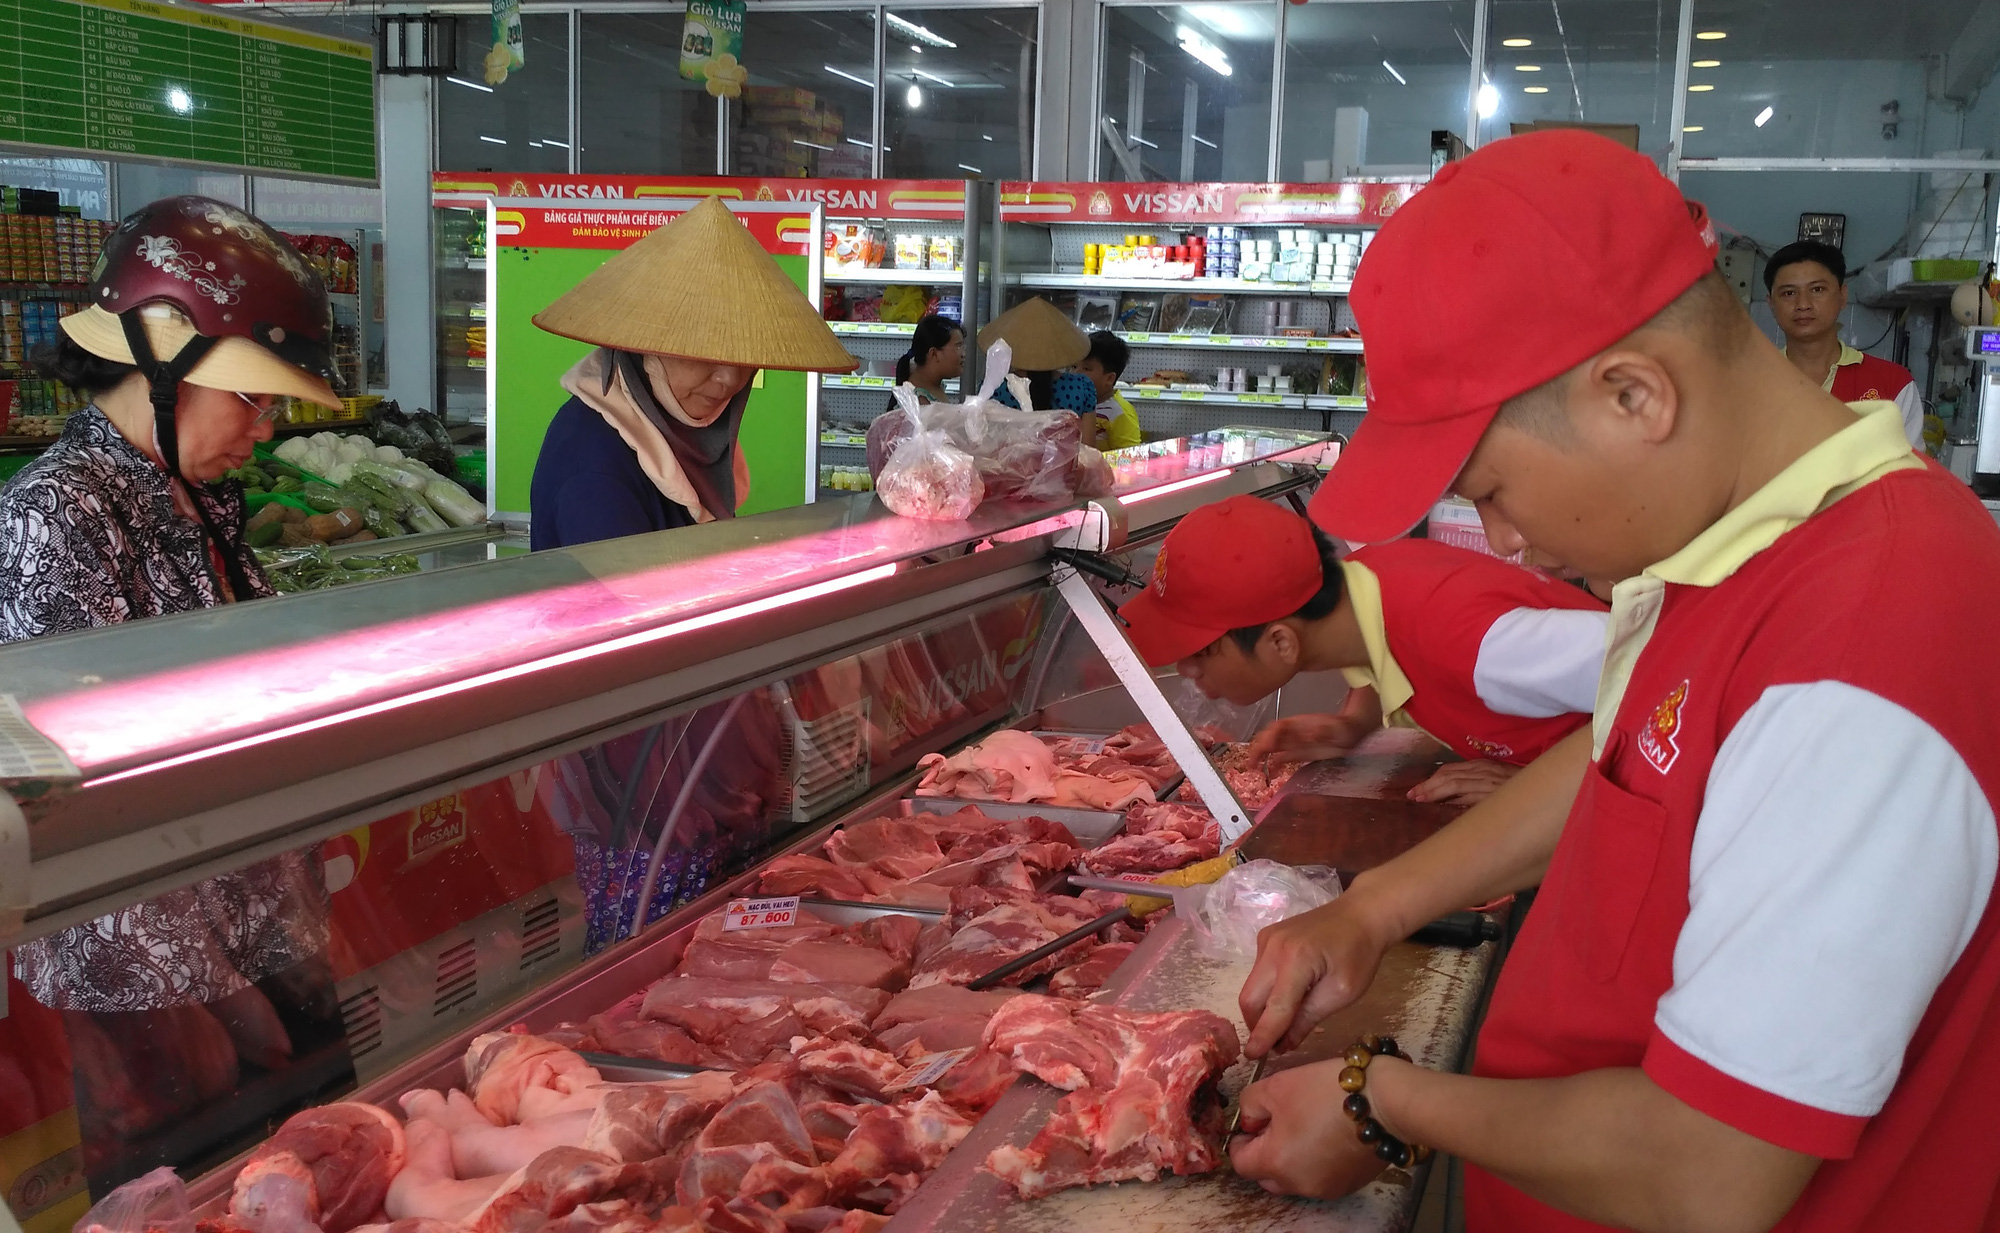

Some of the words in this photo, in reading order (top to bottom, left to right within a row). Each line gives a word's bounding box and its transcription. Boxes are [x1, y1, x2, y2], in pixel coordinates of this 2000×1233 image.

[690, 2, 714, 16] Giò
[786, 189, 877, 210] VISSAN
[1123, 193, 1224, 213] VISSAN
[544, 209, 568, 224] BẢNG
[568, 210, 582, 224] GIÁ
[583, 212, 605, 226] THỰC
[632, 211, 648, 225] CHẾ
[649, 211, 668, 226] BIẾN
[622, 229, 641, 238] SINH
[917, 649, 998, 721] VISSAN
[417, 822, 459, 846] VISSAN
[783, 900, 794, 908] HEO
